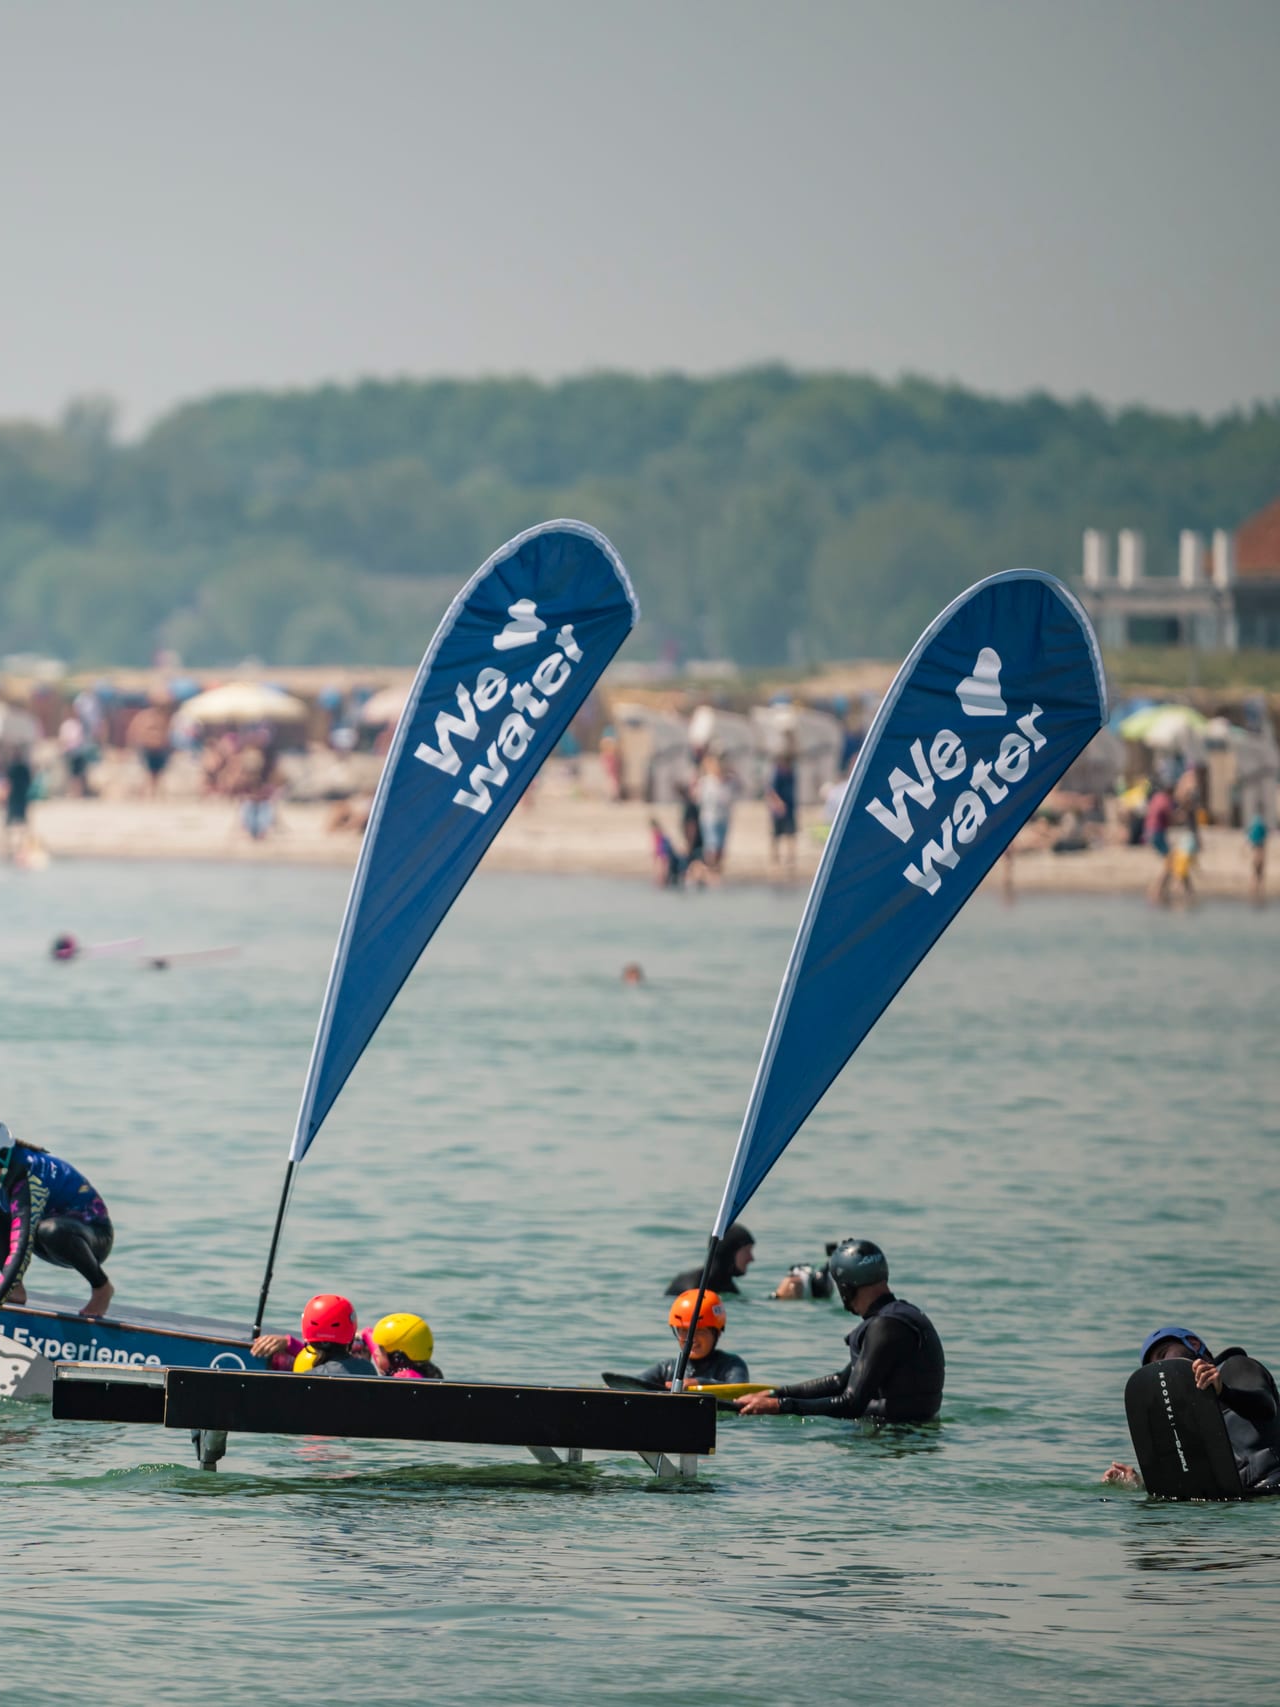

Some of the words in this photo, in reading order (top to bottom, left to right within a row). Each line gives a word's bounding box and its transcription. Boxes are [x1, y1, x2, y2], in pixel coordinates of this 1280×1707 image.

[413, 667, 508, 777] We
[452, 623, 584, 815] water
[865, 728, 967, 844] We
[902, 702, 1048, 897] water
[13, 1327, 162, 1367] Experience
[1158, 1371, 1175, 1421] TAKOON
